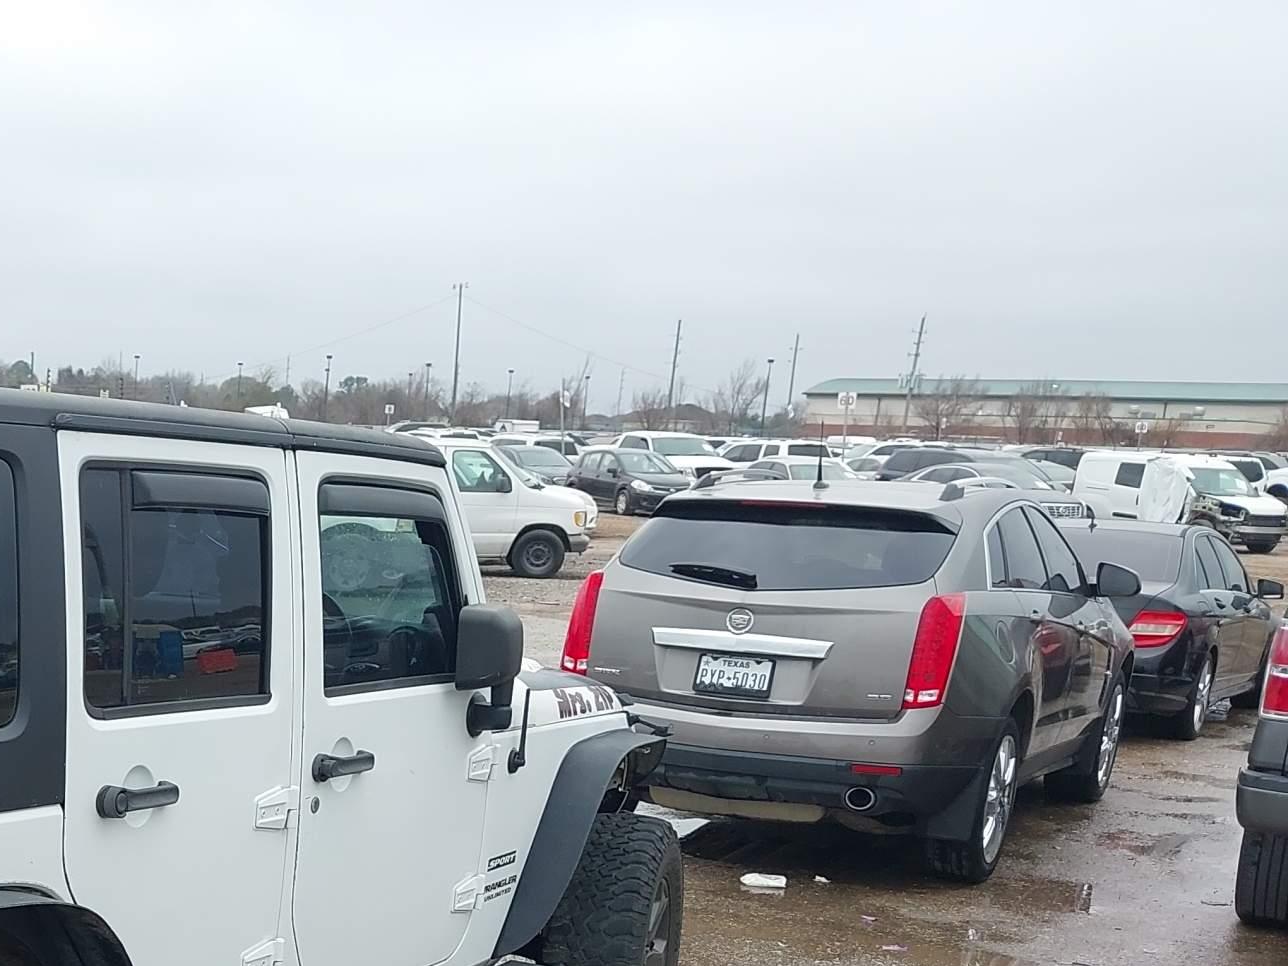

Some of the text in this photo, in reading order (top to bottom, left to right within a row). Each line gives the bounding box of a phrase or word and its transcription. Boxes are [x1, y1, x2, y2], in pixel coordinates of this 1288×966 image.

[722, 659, 751, 669] TEXAS
[488, 853, 516, 868] SPORT
[484, 874, 517, 893] RANGLER
